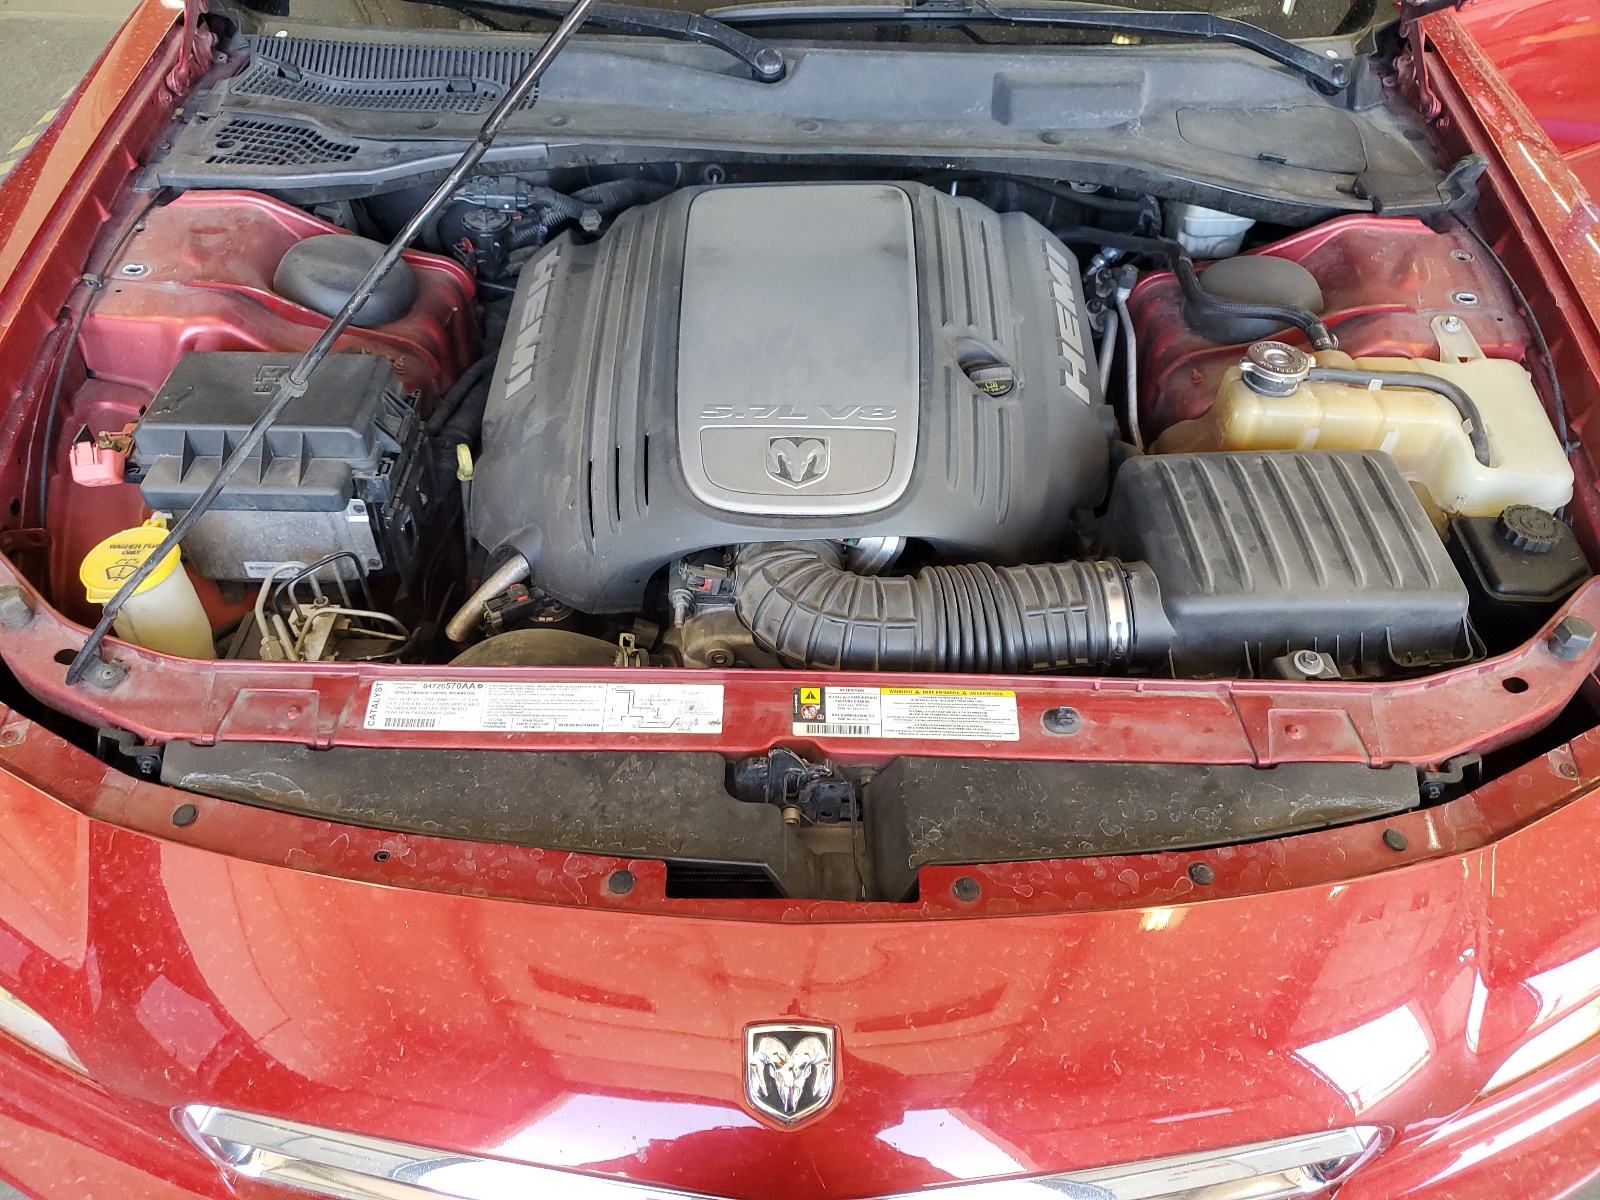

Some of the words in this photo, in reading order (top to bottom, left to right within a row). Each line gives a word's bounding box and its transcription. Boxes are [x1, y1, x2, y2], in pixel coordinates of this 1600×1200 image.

[505, 246, 560, 400] HEMI
[1045, 241, 1090, 405] HEMI
[700, 404, 808, 419] 5.7L
[820, 405, 897, 420] V8
[367, 681, 384, 727] CATALYST
